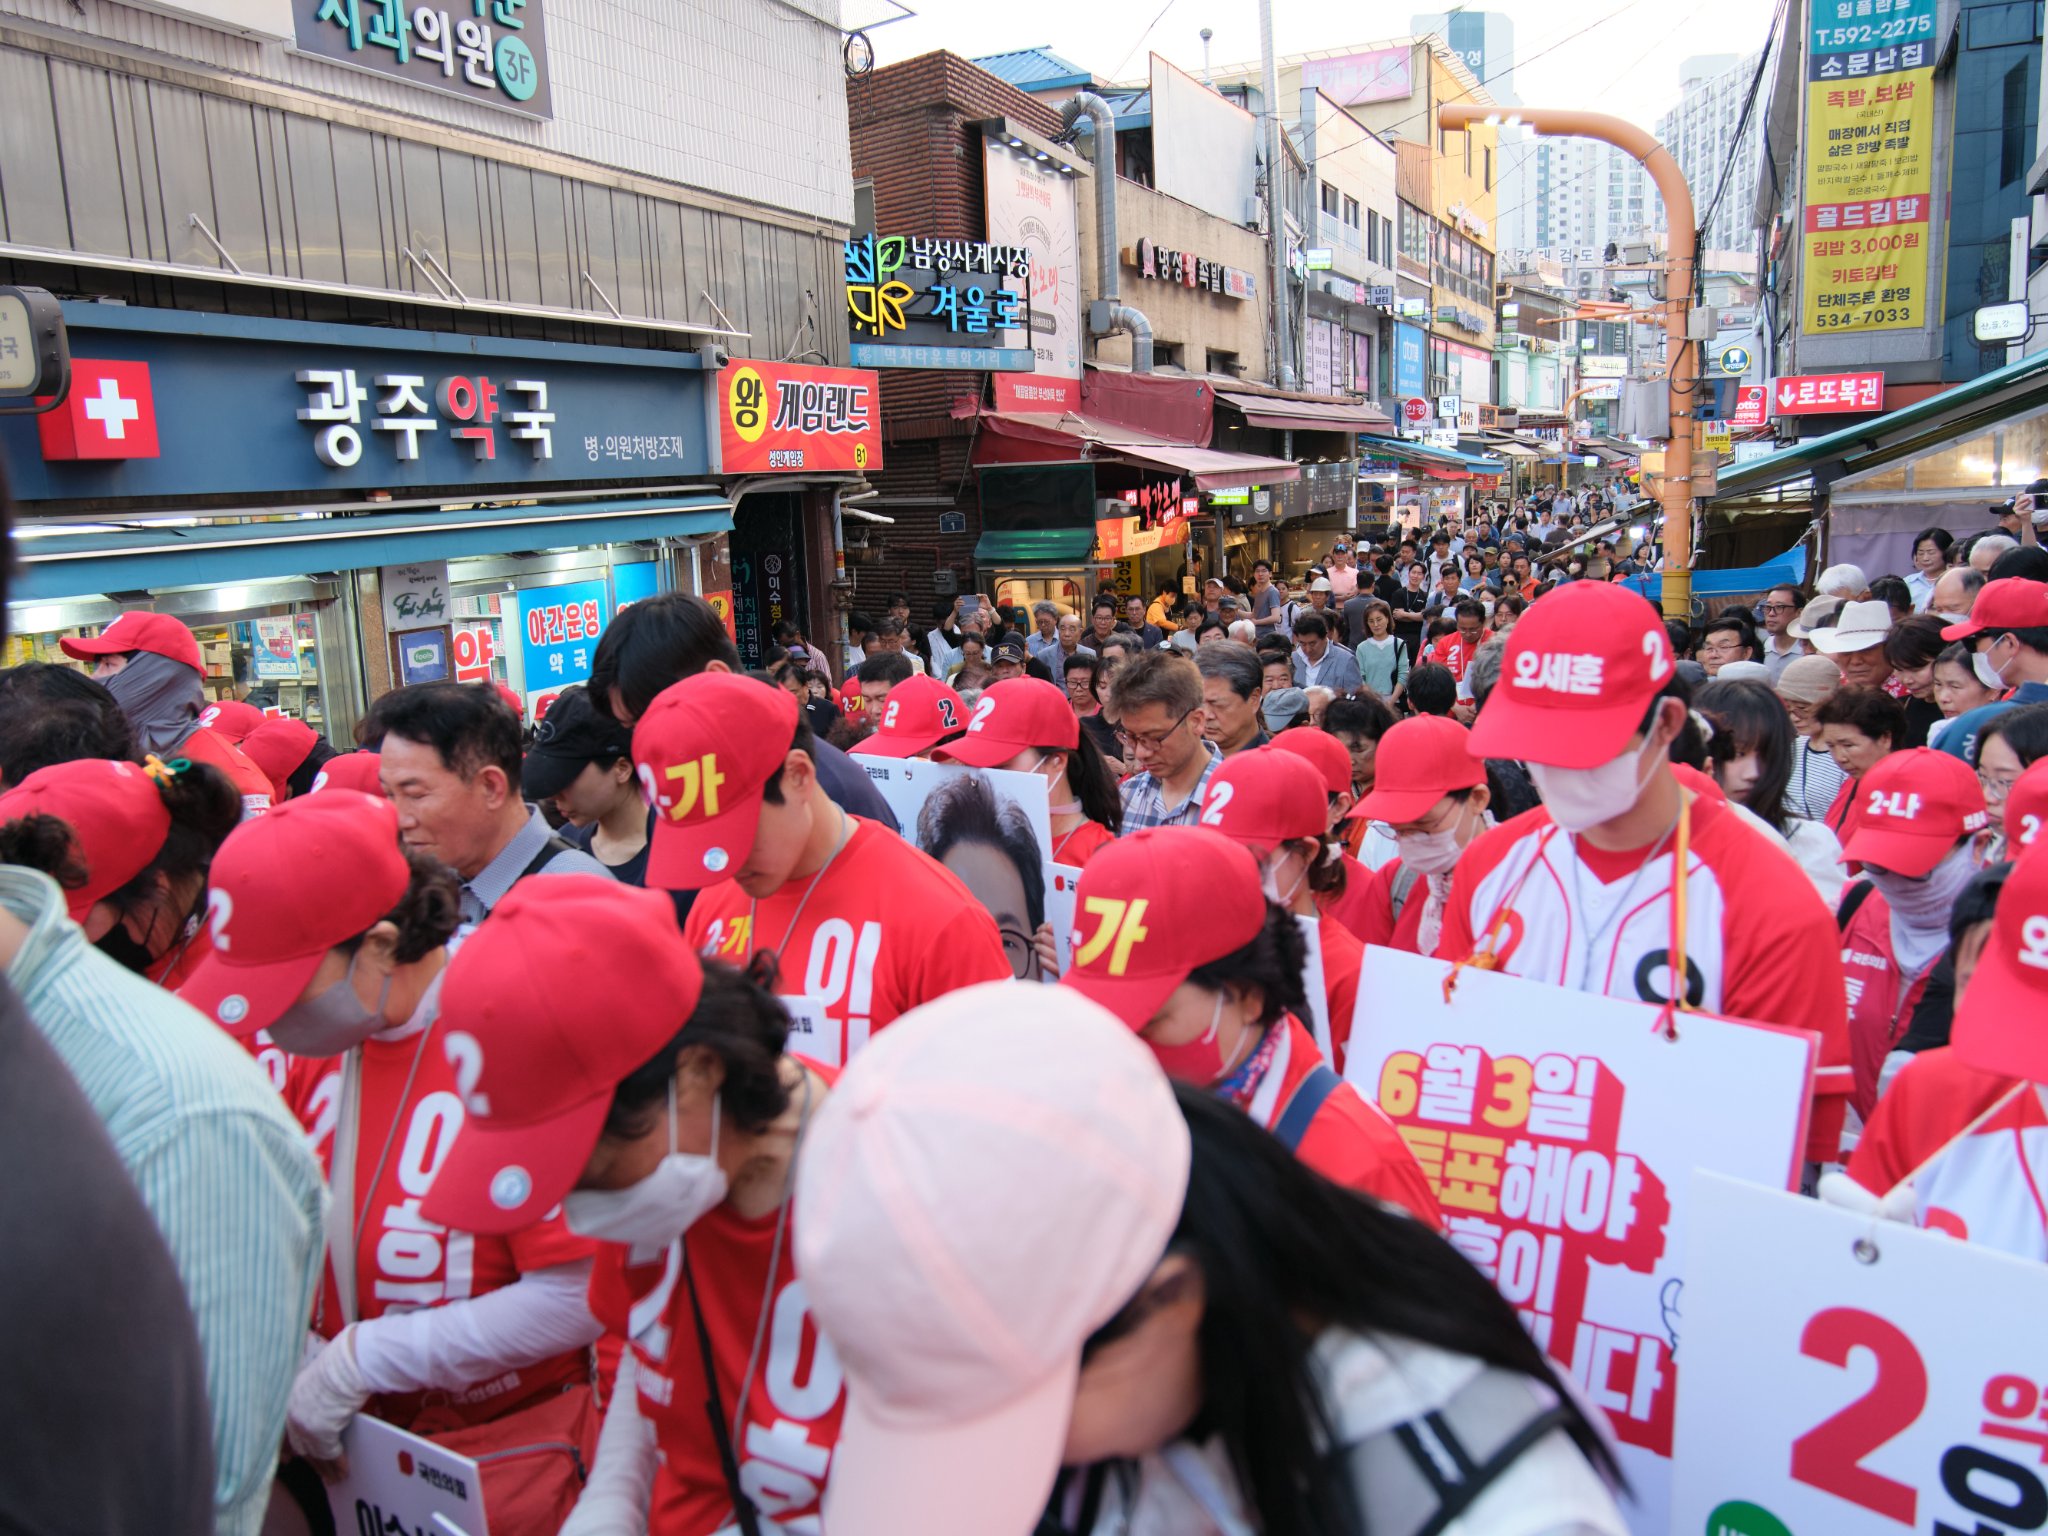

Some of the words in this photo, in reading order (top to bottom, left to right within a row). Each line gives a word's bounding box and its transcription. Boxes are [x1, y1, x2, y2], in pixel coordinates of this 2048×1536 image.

[1815, 14, 1931, 46] T.592-2275
[504, 49, 531, 84] 3F
[1828, 124, 1881, 141] 매장에서
[1885, 119, 1911, 134] 직접
[1828, 144, 1853, 158] 삶은
[1856, 140, 1881, 155] 한방
[1884, 136, 1910, 150] 족발
[912, 236, 1031, 278] 남성사계시장
[1813, 240, 1845, 257] 김밥
[1850, 233, 1919, 255] 3,000원
[1155, 246, 1221, 294] 명성왕족발
[1832, 264, 1899, 284] 키토김밥
[930, 285, 1021, 333] 겨울로
[1818, 290, 1876, 308] 단체주문
[1881, 287, 1911, 303] 환영
[1817, 308, 1910, 328] 534-7033
[884, 347, 1001, 365] 먹자타운특화거리
[735, 377, 763, 428] 왕
[772, 380, 871, 435] 게임랜드
[1736, 400, 1760, 410] otto
[1797, 378, 1878, 407] 로또복권
[296, 369, 556, 468] 광주약국
[1406, 405, 1426, 416] 안경
[584, 435, 684, 461] 병·의원처방조제
[769, 449, 804, 468] 성인게임장
[857, 449, 866, 463] B1
[527, 600, 601, 646] 야간운영
[1642, 630, 1670, 682] 2
[1512, 651, 1604, 695] 오세훈
[200, 707, 221, 728] 2
[884, 701, 899, 728] 2
[938, 698, 959, 729] 2
[967, 697, 995, 732] 2
[1202, 780, 1234, 825] 2
[1866, 790, 1921, 819] 2-나
[2020, 814, 2041, 844] 2
[444, 1030, 491, 1118] 2
[1378, 1044, 1481, 1126] 6월
[1482, 1054, 1600, 1142] 3일
[1789, 1306, 1929, 1529] 2
